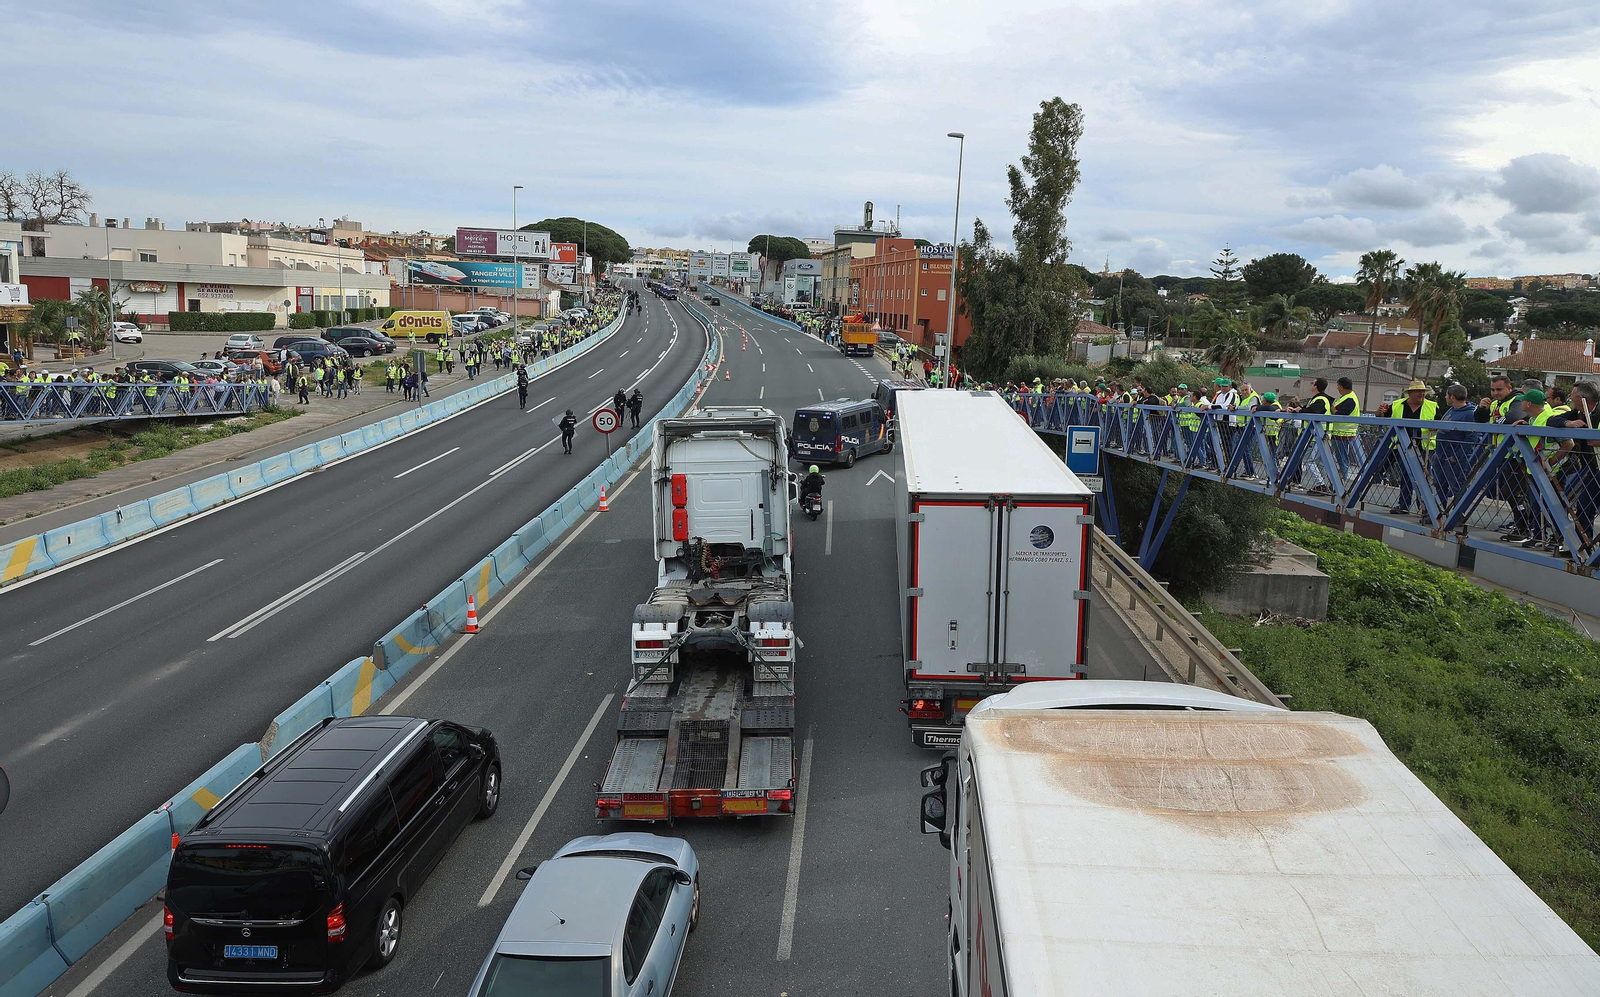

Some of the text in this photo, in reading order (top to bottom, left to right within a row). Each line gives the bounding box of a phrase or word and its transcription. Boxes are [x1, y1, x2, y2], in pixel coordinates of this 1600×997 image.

[399, 315, 442, 328] donuts
[599, 417, 613, 425] 50
[841, 435, 859, 445] POLICÍA
[797, 442, 830, 450] POLICÍA
[231, 947, 276, 957] 4331 MND
